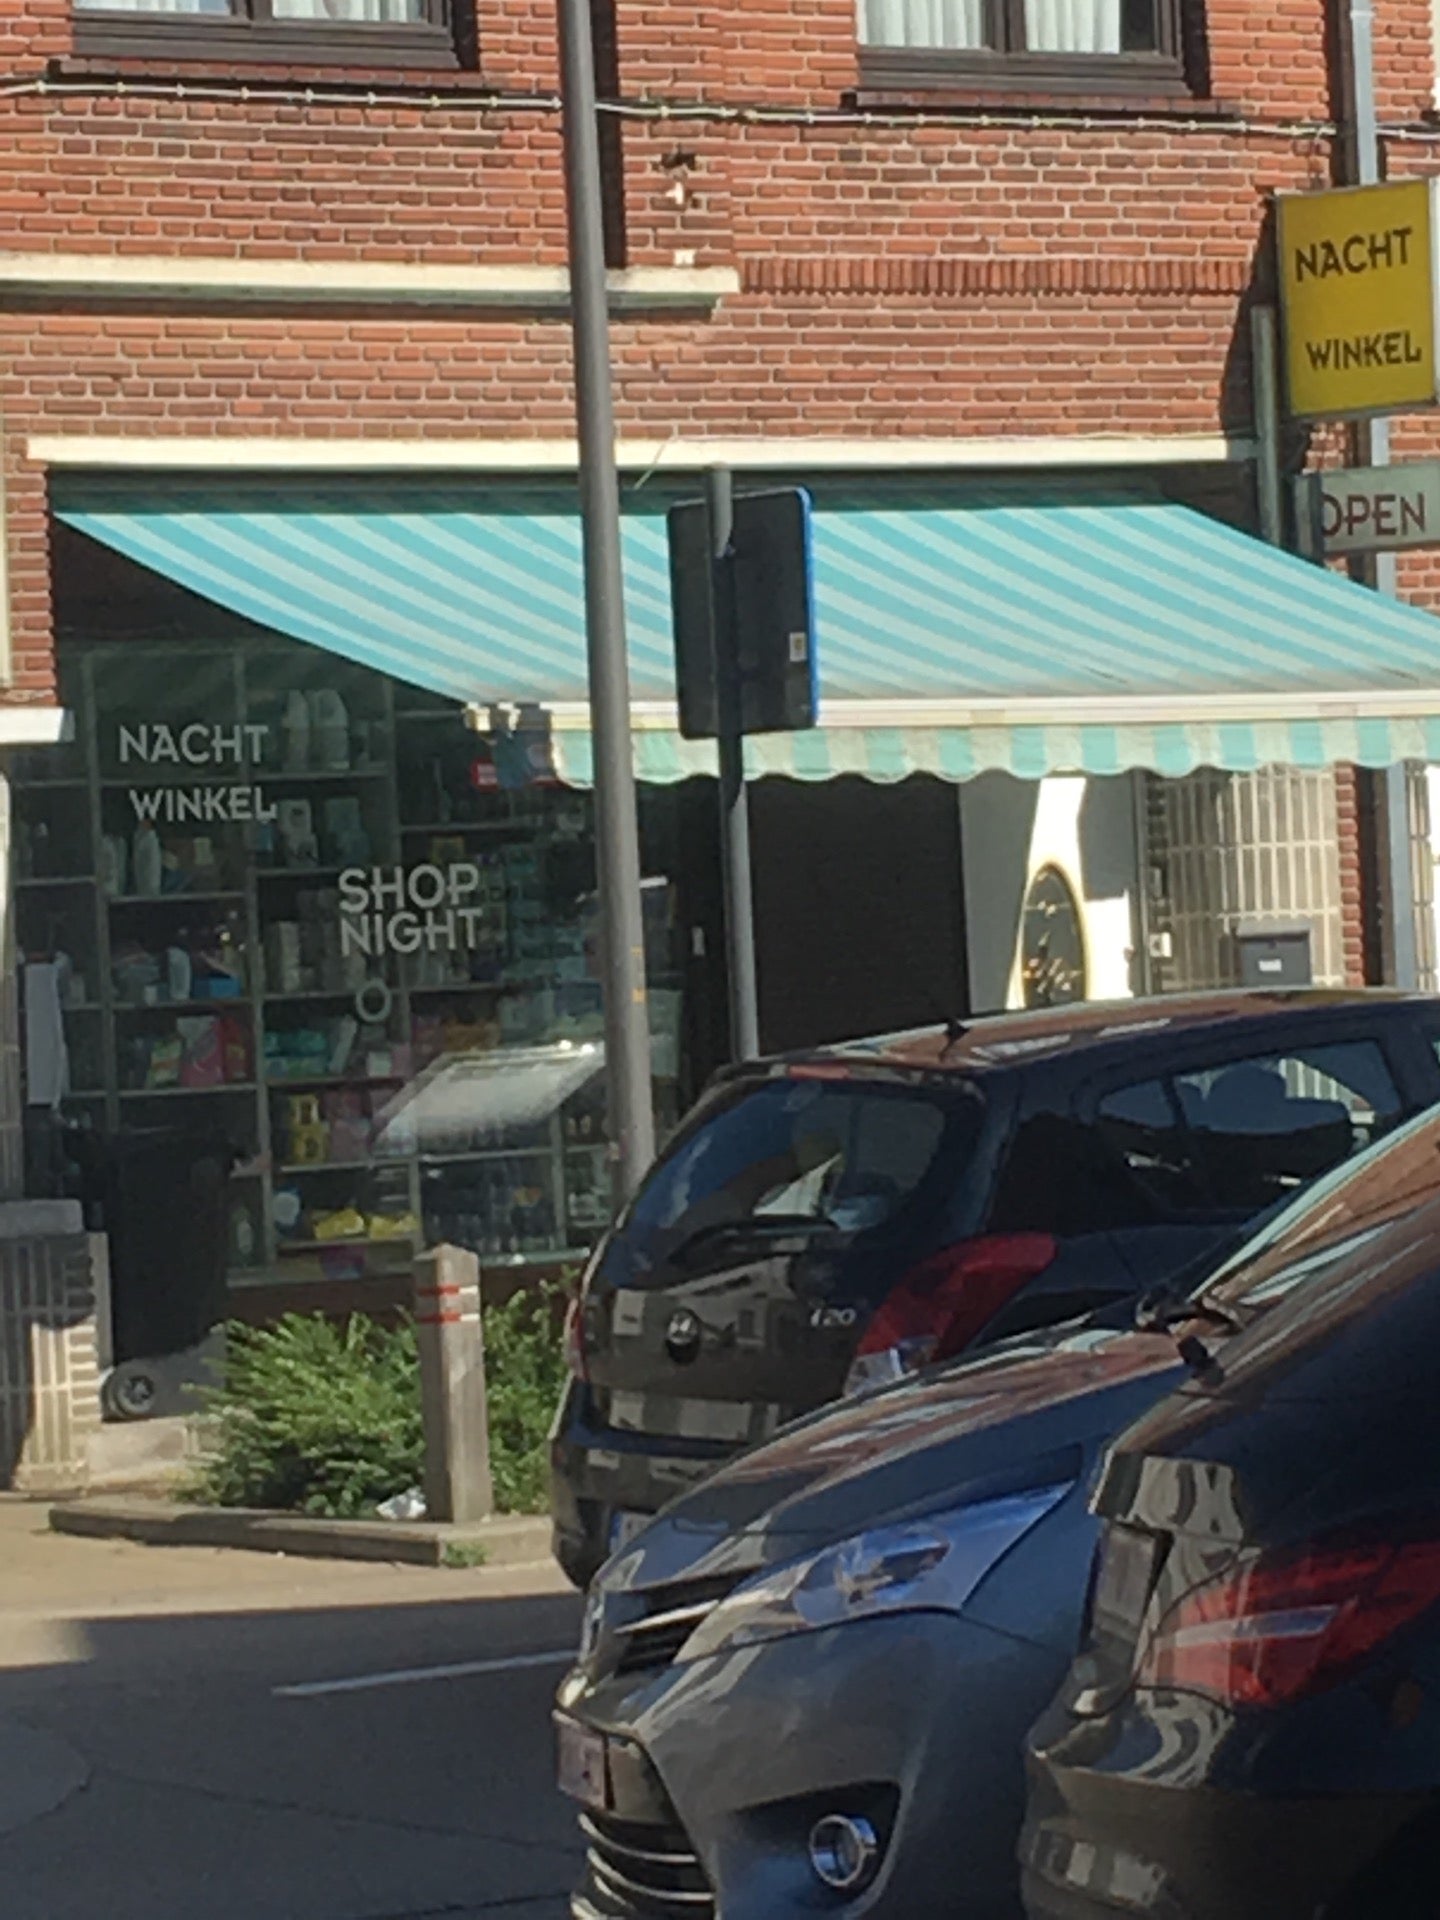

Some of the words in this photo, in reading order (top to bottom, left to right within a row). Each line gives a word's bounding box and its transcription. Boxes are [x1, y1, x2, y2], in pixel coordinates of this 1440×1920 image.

[1295, 226, 1413, 282] NACHT
[1305, 330, 1422, 370] WINKEL
[1321, 492, 1426, 536] OPEN
[119, 723, 269, 764] NACHT
[129, 786, 278, 823] WINKEL
[338, 863, 479, 913] SHOP
[341, 907, 484, 958] NIGHT
